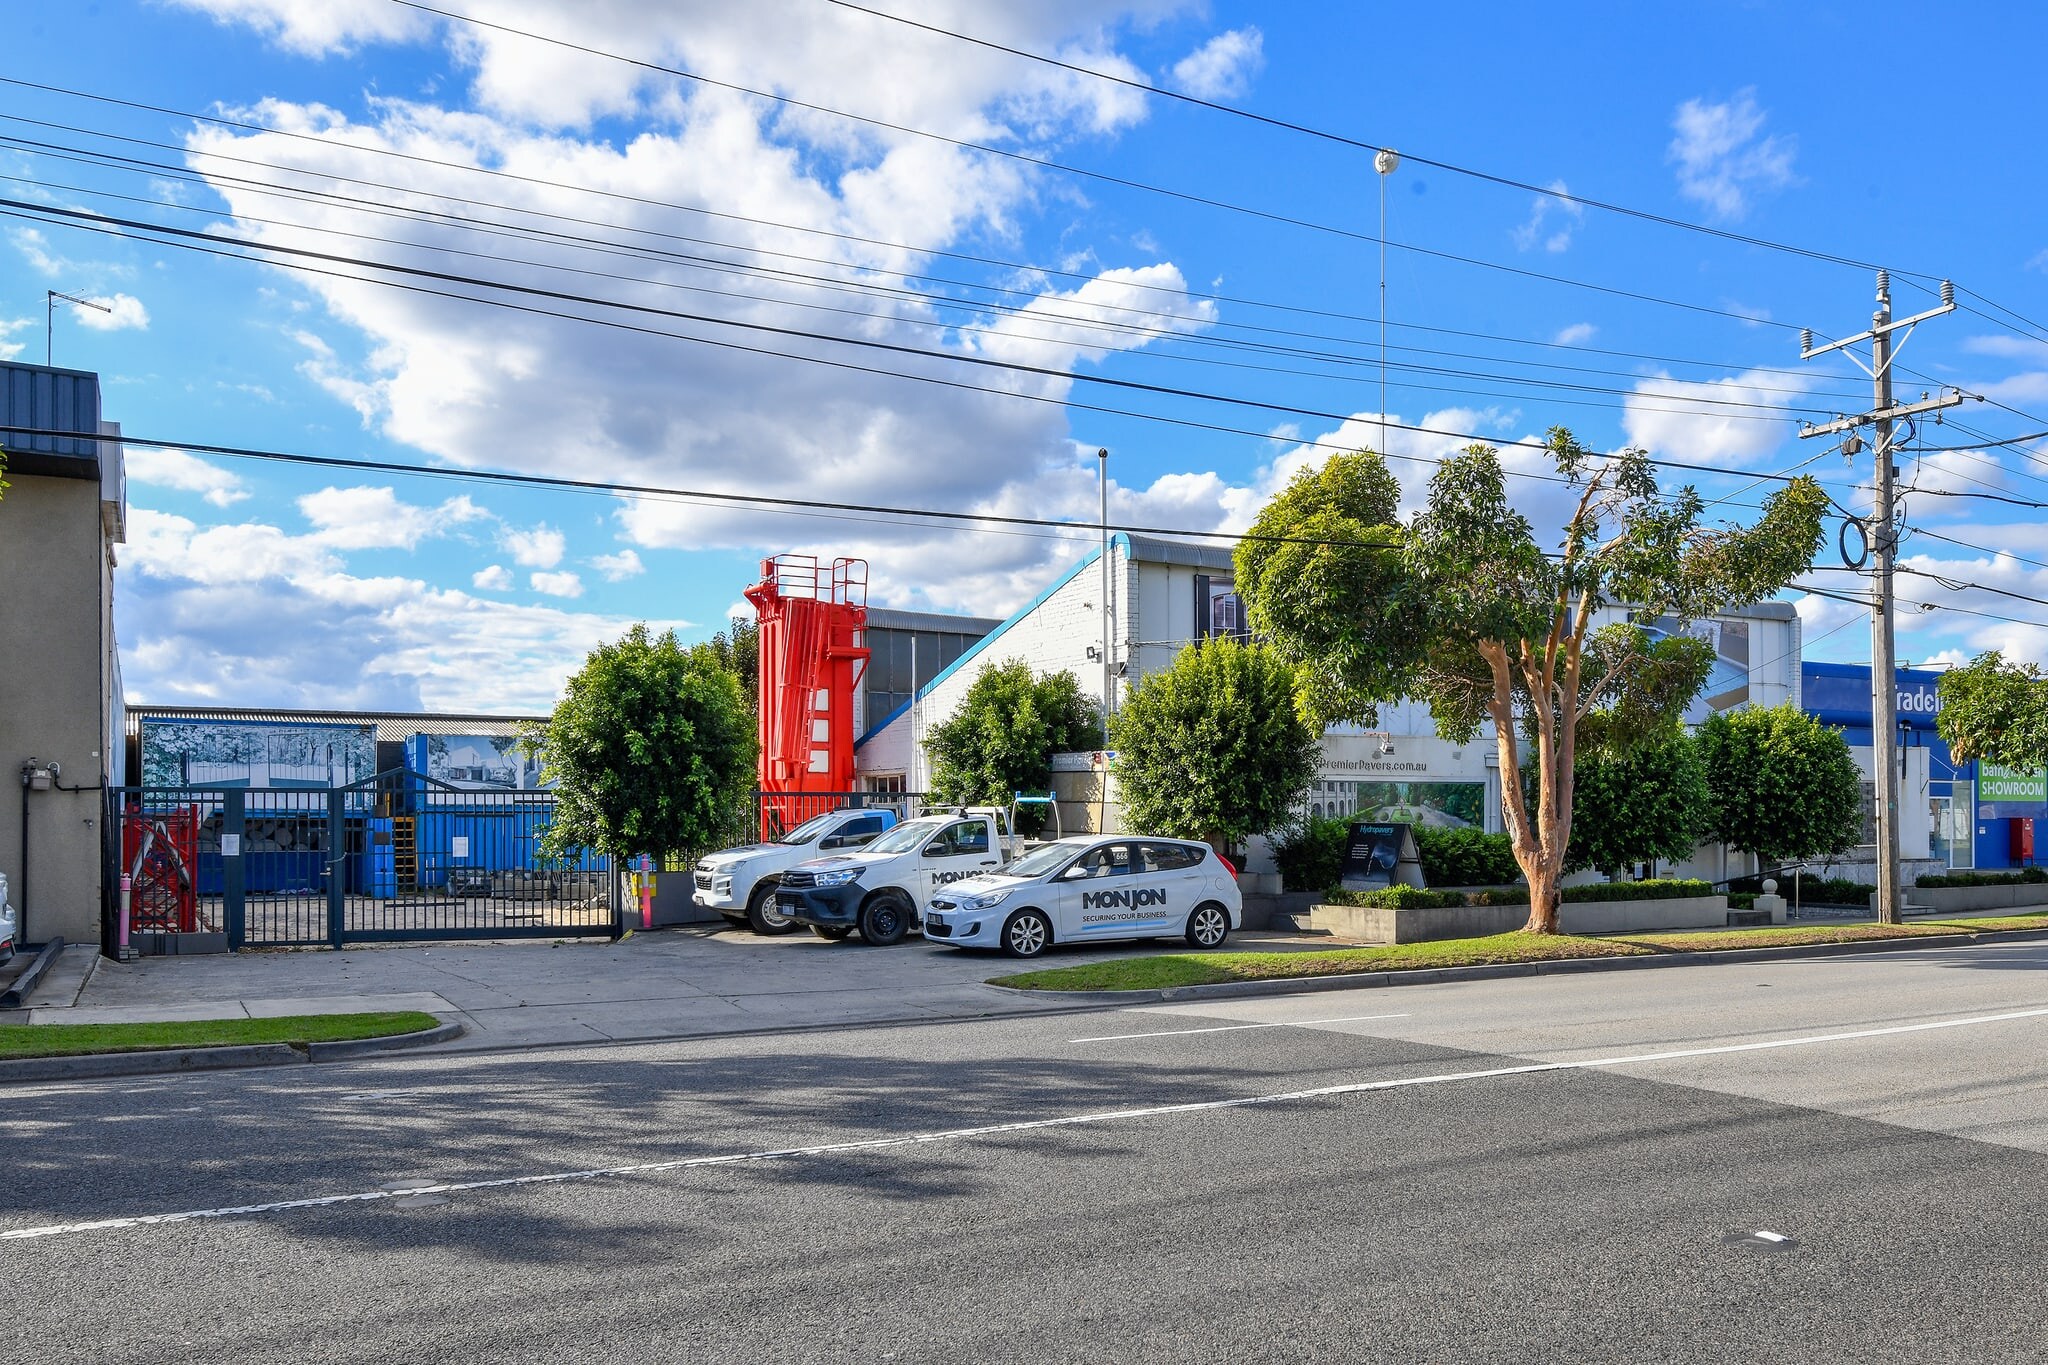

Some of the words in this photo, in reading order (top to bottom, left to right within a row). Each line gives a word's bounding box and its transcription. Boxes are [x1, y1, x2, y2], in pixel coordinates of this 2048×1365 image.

[1982, 781, 2044, 796] SHOWROOM
[1360, 825, 1394, 834] Hydropavers
[931, 870, 989, 884] MON
[1083, 888, 1166, 911] MONJON
[1082, 914, 1116, 923] SECURING
[1117, 912, 1136, 921] YOUR
[1137, 910, 1167, 920] BUSINESS
